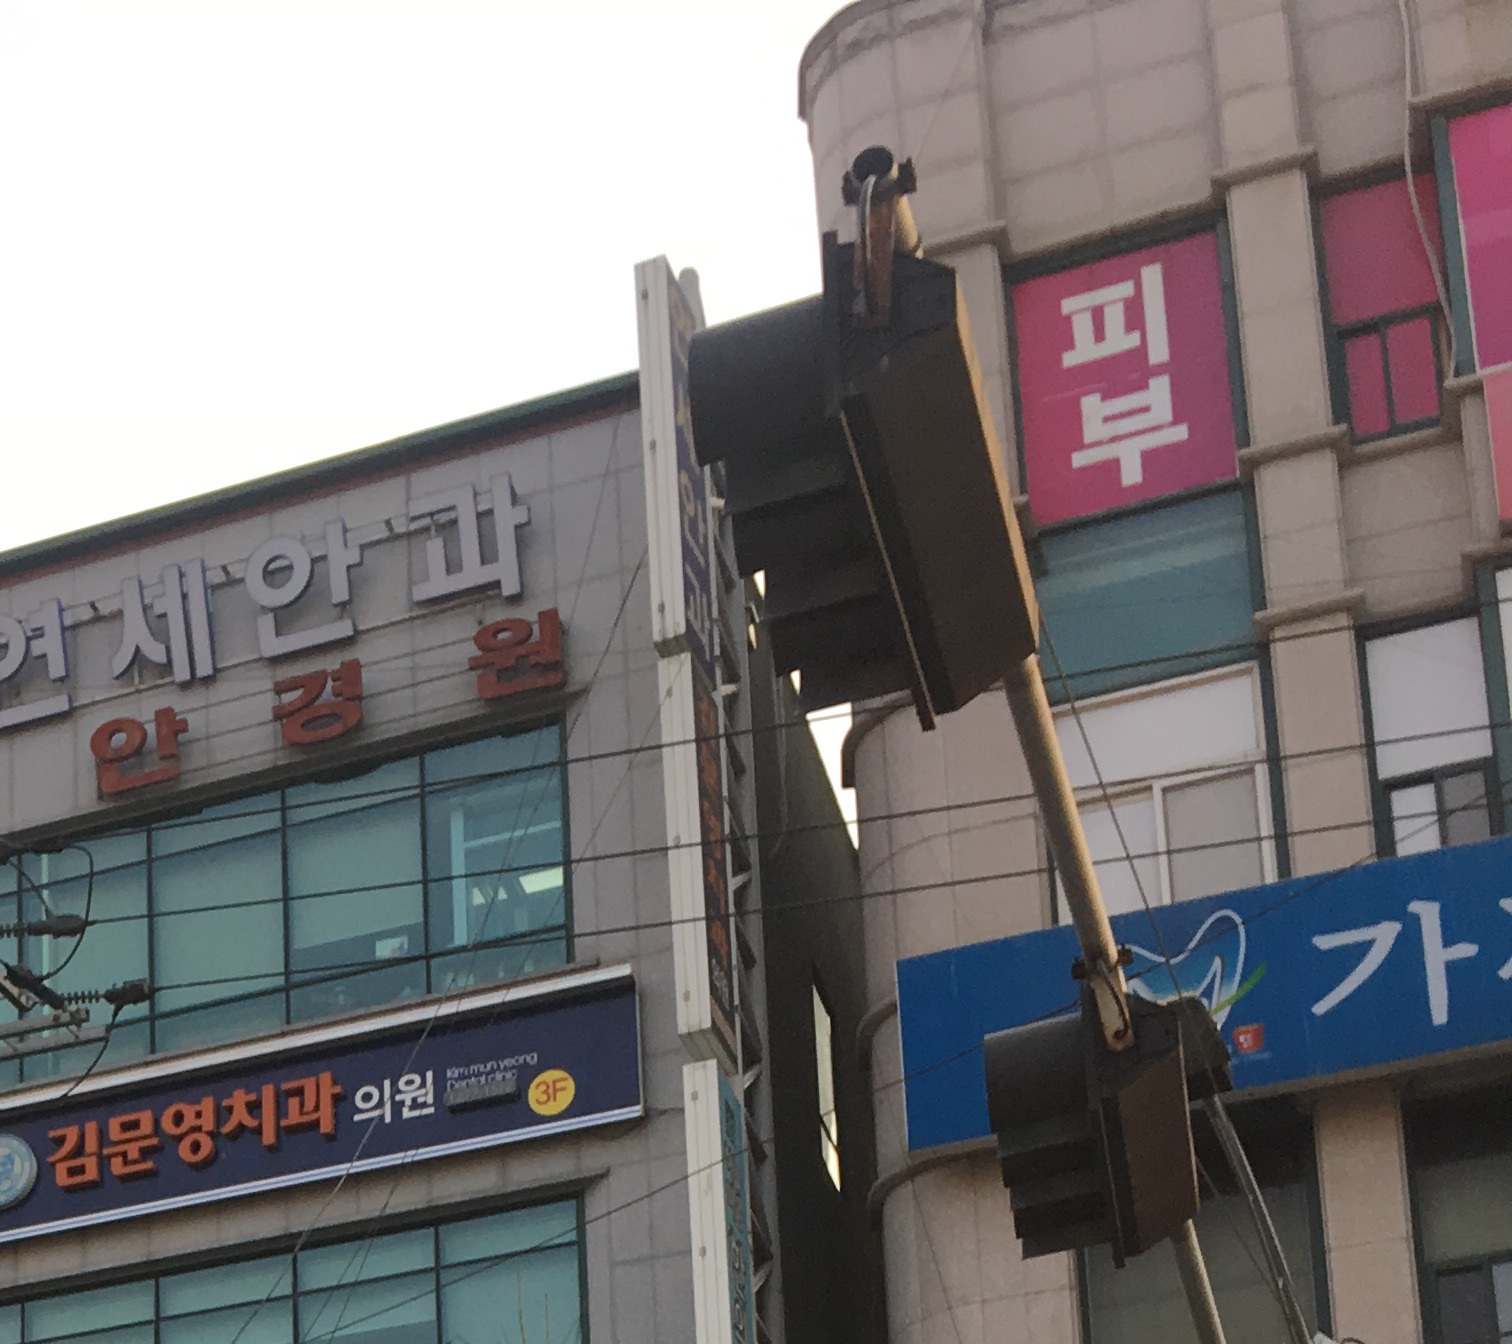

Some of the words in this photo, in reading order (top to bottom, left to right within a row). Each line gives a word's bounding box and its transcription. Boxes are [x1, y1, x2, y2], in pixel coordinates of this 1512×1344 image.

[1060, 262, 1190, 488] 피부
[90, 606, 567, 798] 안경원
[1311, 897, 1512, 1027] 가
[45, 1070, 345, 1191] 김문영치과
[351, 1070, 436, 1125] 의원
[534, 1075, 570, 1106] 3F
